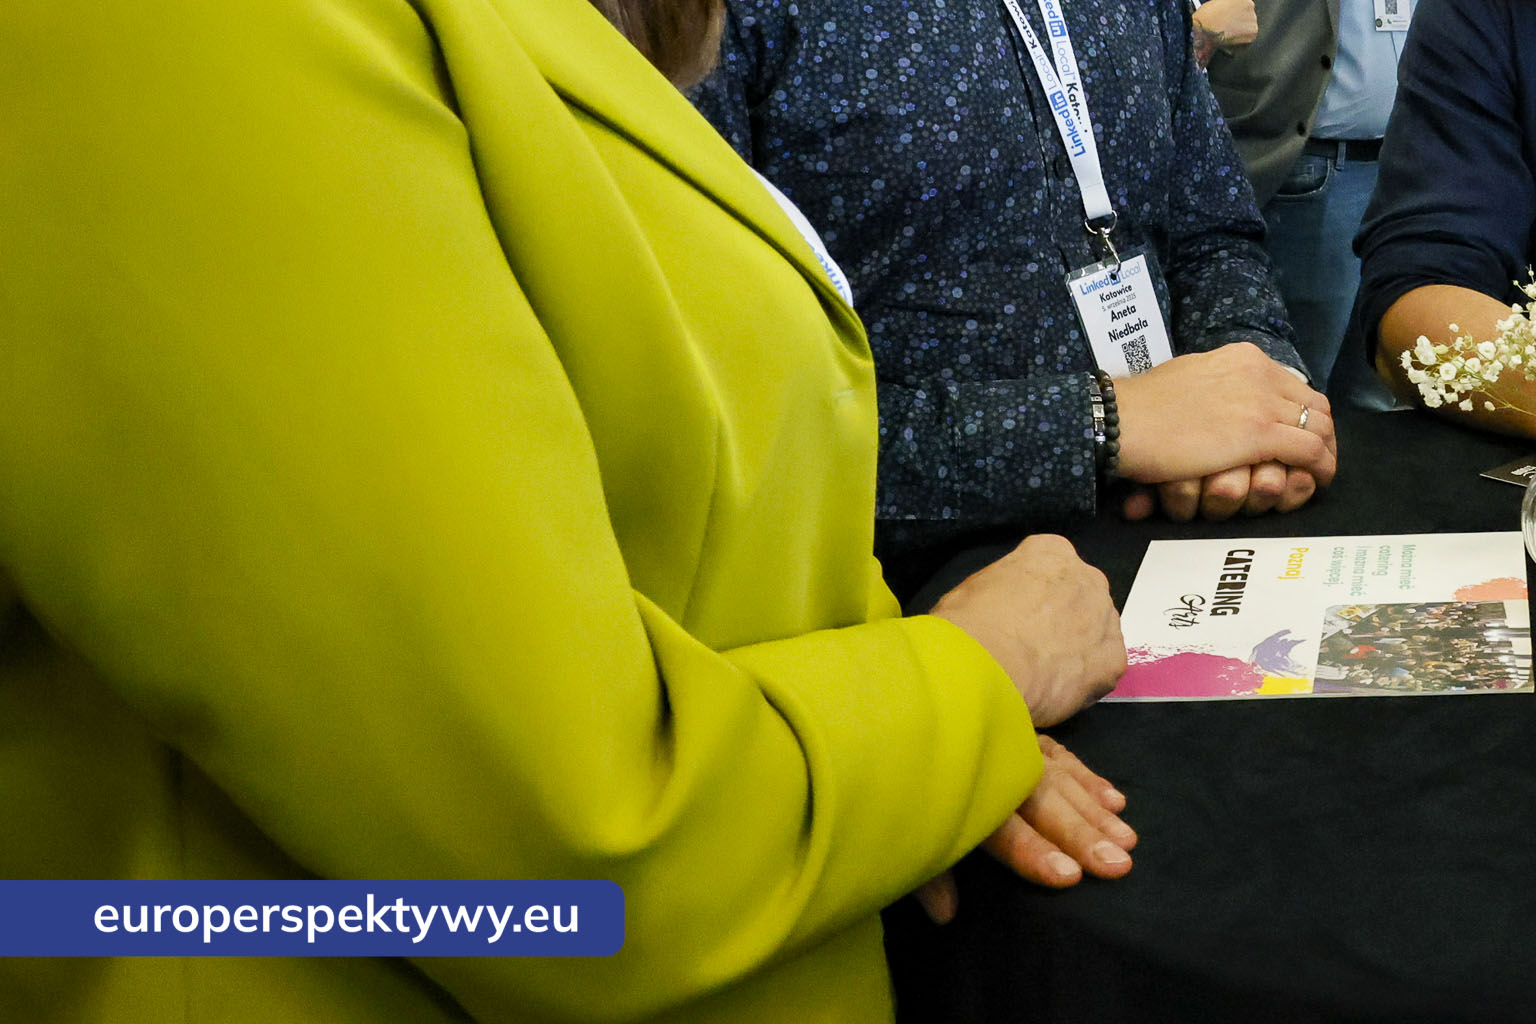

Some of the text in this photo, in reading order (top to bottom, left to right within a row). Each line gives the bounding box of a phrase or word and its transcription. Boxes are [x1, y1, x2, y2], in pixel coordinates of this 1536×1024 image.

[1049, 91, 1087, 157] Linkedin
[1079, 270, 1122, 295] Linked
[1099, 284, 1133, 303] Katowice
[1110, 304, 1137, 322] Aneta
[1107, 317, 1149, 343] Niedbała
[1278, 547, 1310, 580] Poznaj
[1371, 545, 1392, 576] catering
[1210, 549, 1256, 617] CATERING
